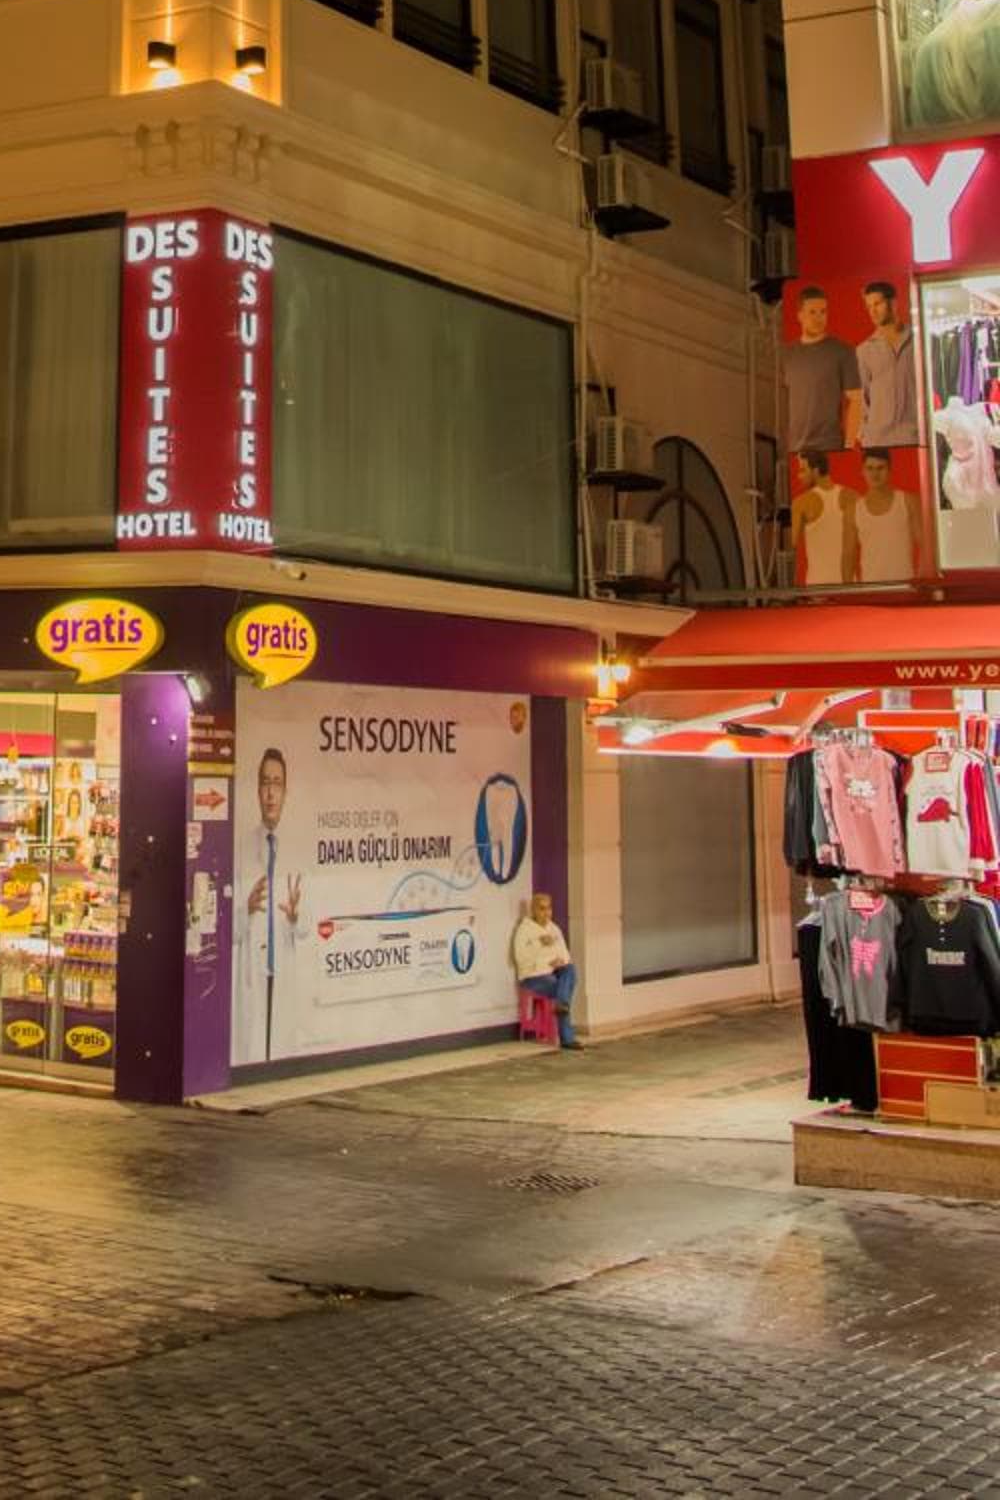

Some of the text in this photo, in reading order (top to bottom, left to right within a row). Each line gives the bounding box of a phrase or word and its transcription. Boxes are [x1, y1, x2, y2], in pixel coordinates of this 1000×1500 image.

[125, 220, 200, 264] DES
[225, 221, 273, 271] DES
[145, 266, 175, 505] SUITES
[238, 270, 259, 509] SUITES
[115, 511, 197, 539] HOTEL
[218, 513, 273, 544] HOTEL
[48, 608, 144, 654] gratis
[245, 615, 309, 657] gratis
[318, 715, 458, 754] SENSODYNE
[317, 832, 452, 868] DAHA GÜÇLÜ ONARIM
[325, 945, 411, 973] SENSODYNE
